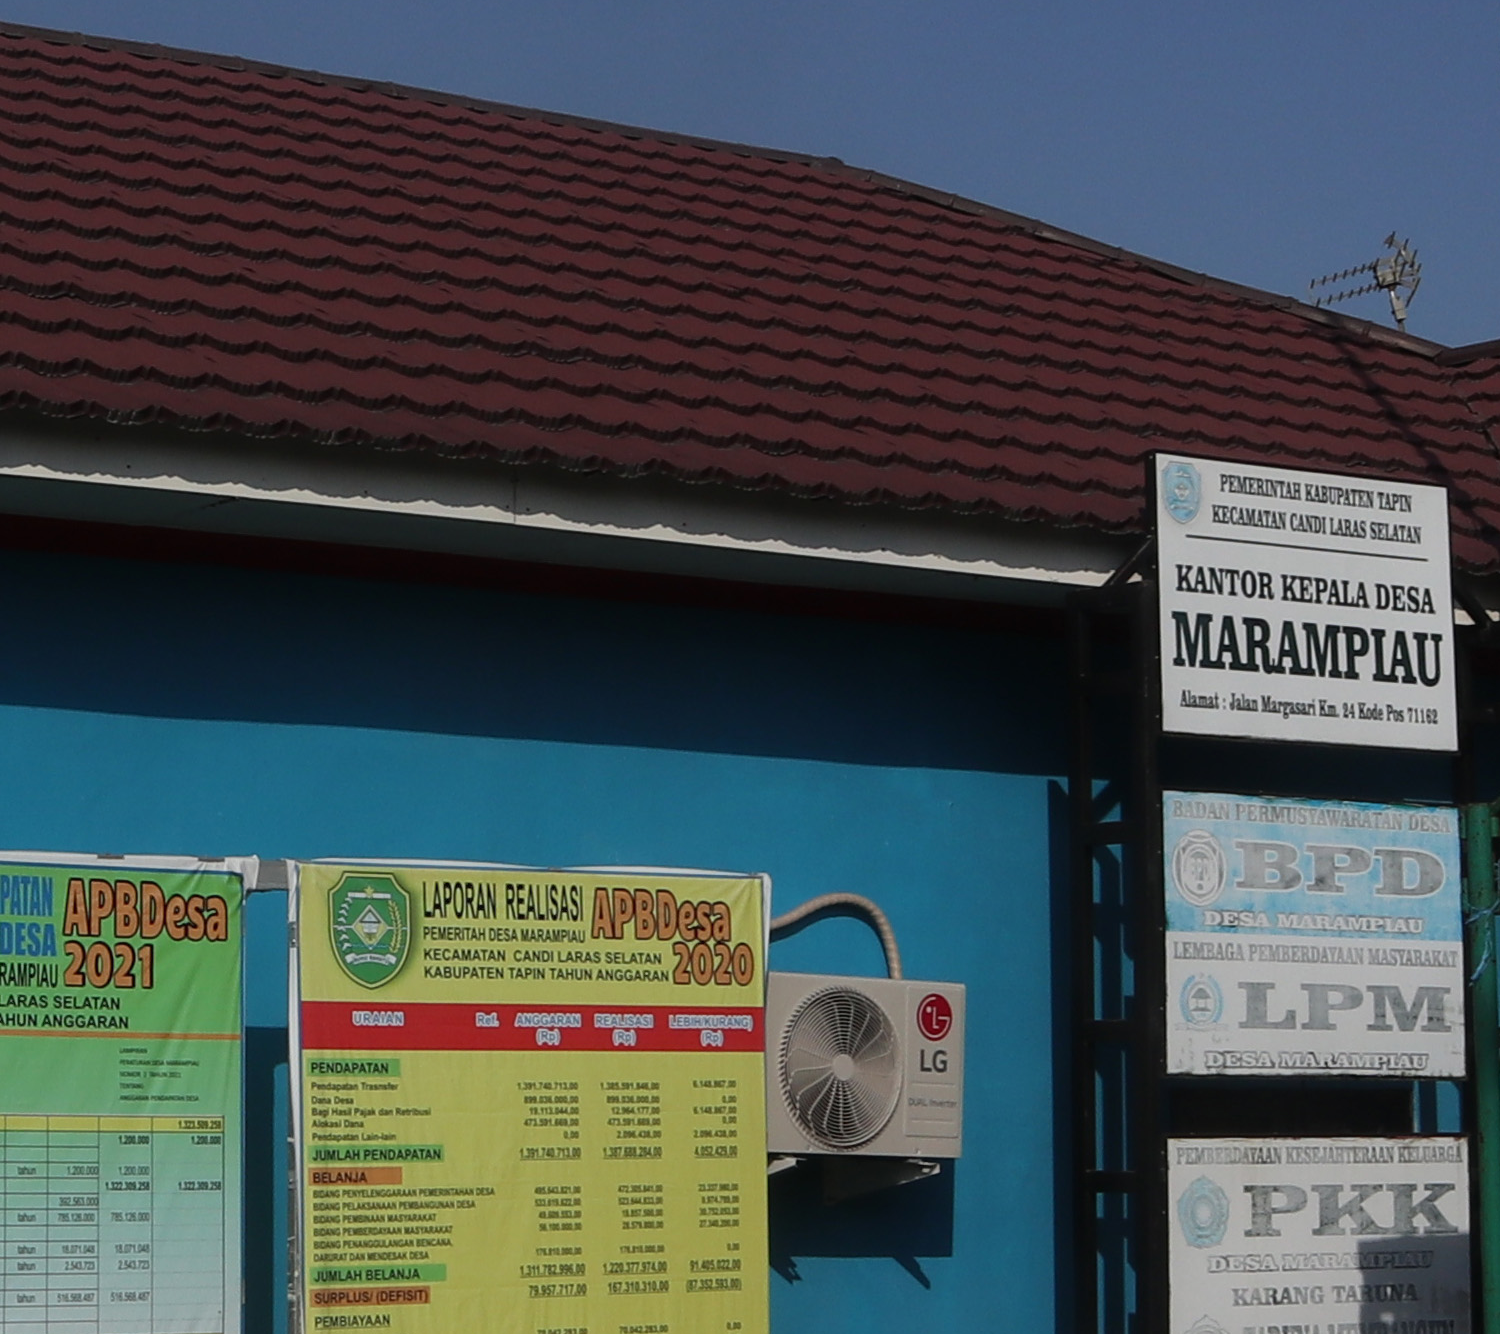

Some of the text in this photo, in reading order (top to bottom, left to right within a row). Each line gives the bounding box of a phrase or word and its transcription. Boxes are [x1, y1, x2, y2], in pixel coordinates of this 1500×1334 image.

[1220, 474, 1412, 512] PEMERINTAH KABUPATEN TAPIN
[1212, 505, 1421, 544] KECAMATAN CANDI LARAS SELATAN
[1175, 564, 1436, 614] KANTOR KEPALA DESA
[1171, 611, 1443, 687] MARAMPIAU
[1180, 689, 1219, 709] Alamat
[1229, 692, 1259, 712] Jalan
[1261, 695, 1316, 719] Margasari
[1319, 699, 1339, 717] Km.
[1342, 702, 1356, 719] 24
[1358, 702, 1384, 721] Kode
[1386, 704, 1404, 723] Pos
[1407, 707, 1439, 725] 71162
[1173, 800, 1451, 833] BADAN PERMUSYAWARATAN DESA
[1234, 840, 1446, 897] BPD
[63, 877, 228, 941] APBDesa
[423, 882, 583, 922] LAPORAN REALISASI
[591, 887, 731, 943] APBDesa
[1204, 910, 1425, 934] DESA MARAMPIAU
[0, 921, 57, 957] DESA
[423, 926, 585, 944] PEMERITAH DESA MARAMPIAU
[63, 940, 154, 989] 2021
[424, 949, 662, 965] KECAMATAN CANDI LARAS SELATAN
[672, 941, 754, 986] 2020
[1173, 941, 1458, 968] LEMBAGA PEMBERDAYAAN MASYARAKAT
[424, 966, 669, 982] KABUPATEN TAPIN TAHUN ANGGARAN
[53, 996, 120, 1010] SELATAN
[1237, 981, 1452, 1033] LPM
[41, 1014, 129, 1029] ANGGARAN
[352, 1011, 404, 1026] URAIAN
[475, 1012, 499, 1027] Ref.
[514, 1013, 582, 1028] ANGGARAN
[594, 1013, 654, 1028] REALISASI
[535, 1029, 725, 1047] (Rp) (Rp) (Rp)
[310, 1062, 389, 1075] PENDAPATAN
[919, 1049, 948, 1073] LG
[1205, 1051, 1429, 1070] DESA MARAMPIAU
[311, 1081, 359, 1092] Pendapatan
[311, 1095, 354, 1105] Dana Desa
[908, 1097, 927, 1108] DUAL
[311, 1106, 431, 1118] Bagi Hasil Pajak dan Retribusi
[312, 1119, 364, 1129] Alokasi Dana
[312, 1132, 397, 1143] Pendapatan Lain-lain
[312, 1148, 441, 1162] JUMLAH PENDAPATAN
[1176, 1145, 1463, 1165] PEMBERDAYAAN KESEJAHTERAAN KELUARGA
[313, 1171, 367, 1184] BELANJA
[1243, 1183, 1459, 1237] PKK
[1208, 1250, 1434, 1273] DESA MARAMPIAU
[314, 1268, 420, 1283] JUMLAH BELANJA
[314, 1289, 429, 1305] SURPLUS/ (DEFISIT)
[1232, 1283, 1419, 1307] KARANG TARUNA
[314, 1314, 390, 1329] PEMBIAYAAN
